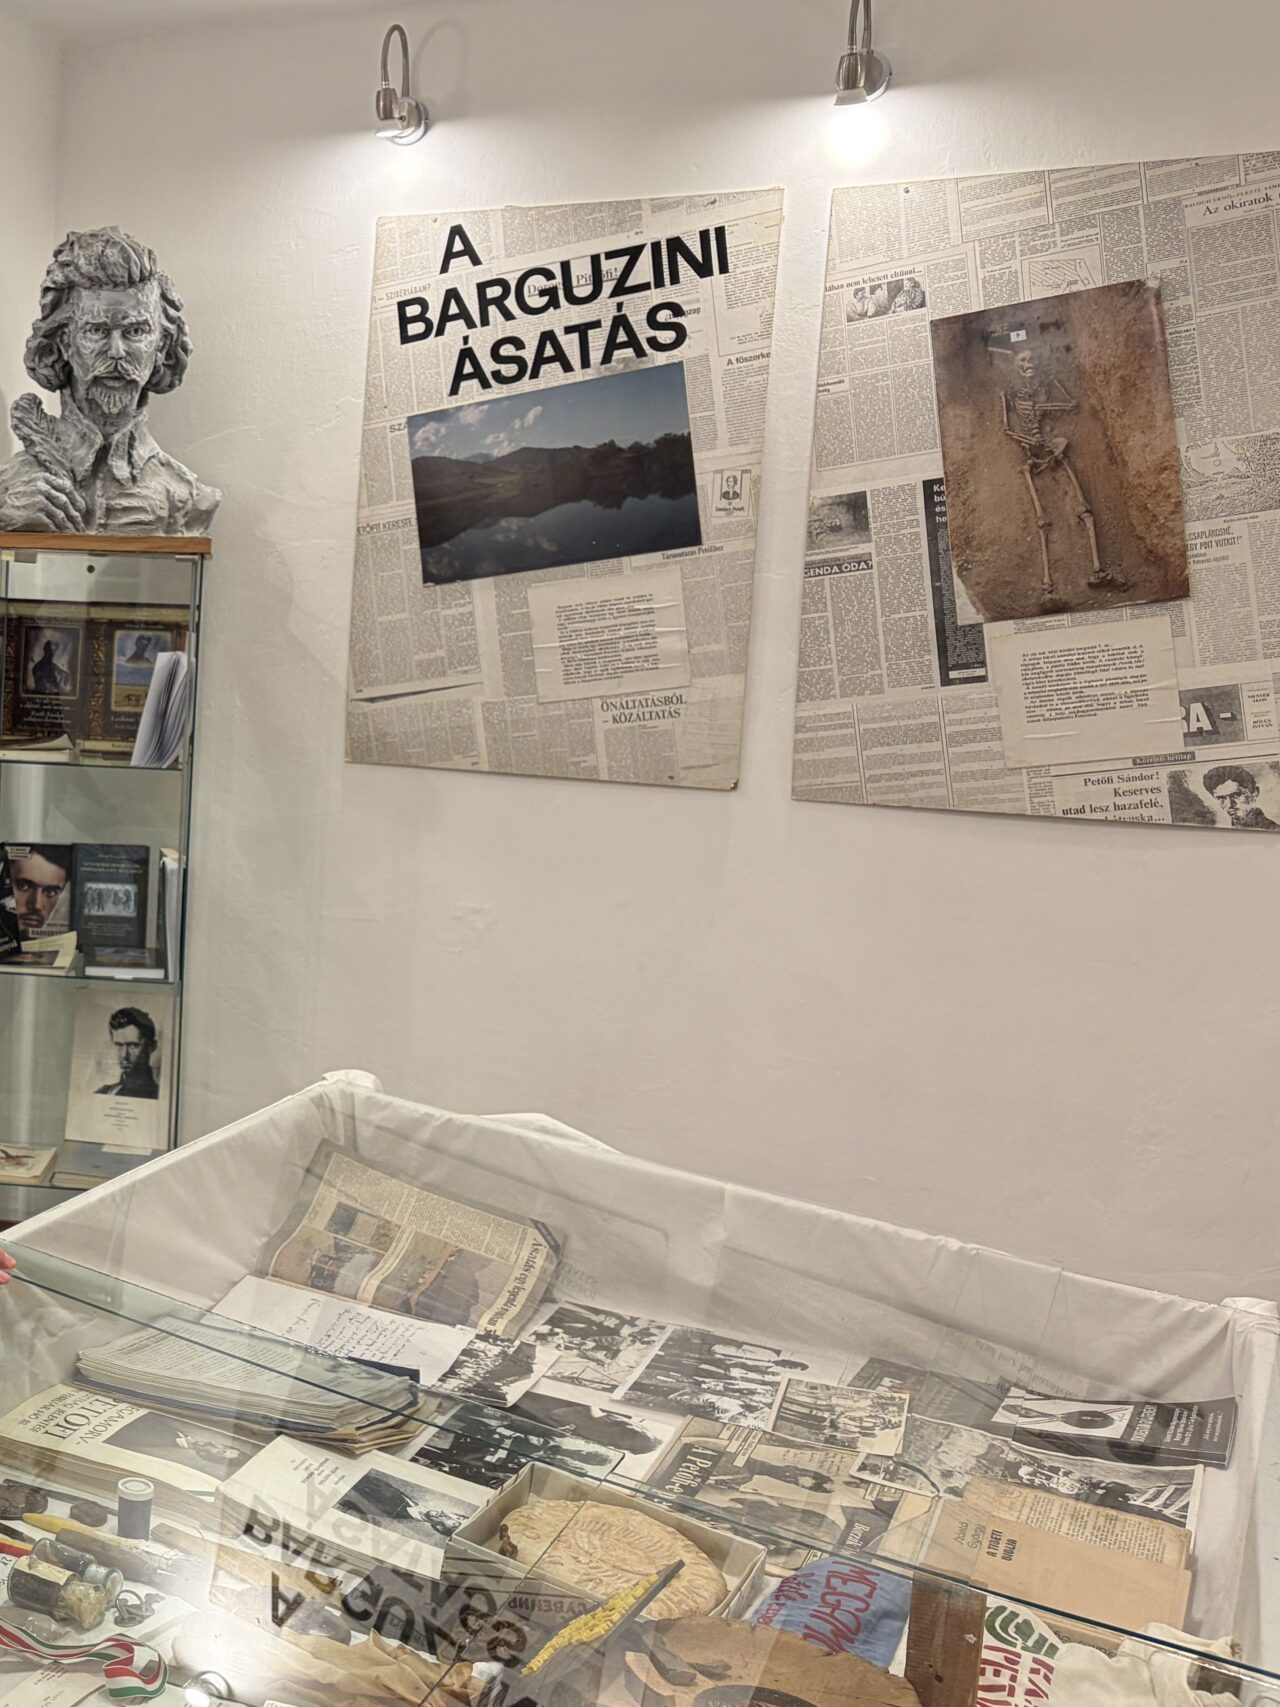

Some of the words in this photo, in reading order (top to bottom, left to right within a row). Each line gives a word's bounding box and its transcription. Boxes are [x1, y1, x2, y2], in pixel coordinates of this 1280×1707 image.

[1203, 206, 1220, 217] Az
[1223, 192, 1273, 212] okiratok
[439, 223, 483, 275] A
[397, 225, 730, 345] BARGUZINI
[448, 301, 688, 397] ÁSATÁS
[726, 357, 734, 366] A
[600, 692, 688, 713] ÖNÁLTATÁSBÓL
[612, 705, 681, 725] KÖZÁLTATÁS
[1083, 776, 1114, 787] Petőfi
[1117, 771, 1160, 784] Sándor!
[1113, 786, 1162, 798] Keserves
[1062, 803, 1086, 816] utad
[1090, 803, 1111, 813] lesz
[1113, 797, 1164, 812] hazafelé,
[43, 1398, 121, 1441] ETŐFI
[691, 1444, 719, 1456] A
[845, 1522, 870, 1547] Borzák
[988, 1529, 1004, 1551] TIBETI
[986, 1550, 997, 1558] A
[1001, 1538, 1018, 1562] BIBLIA
